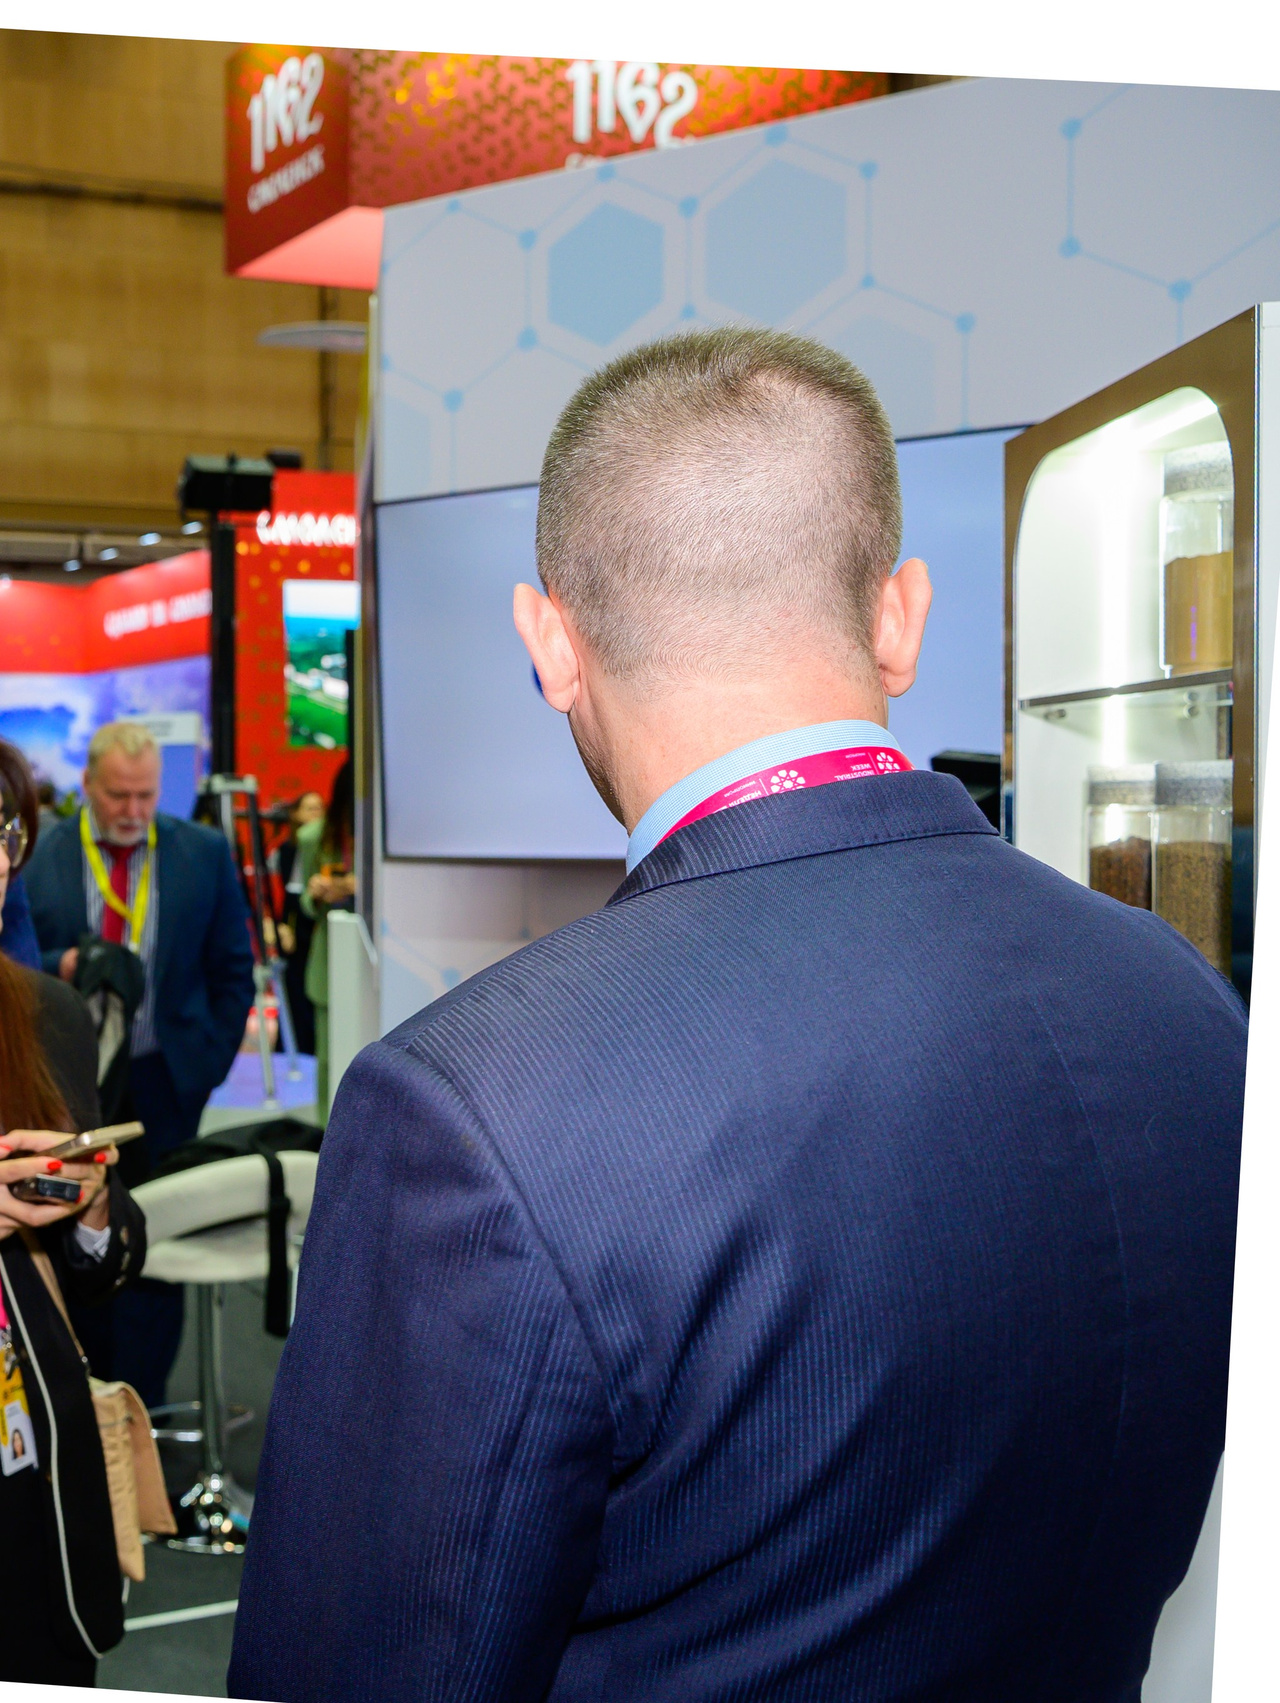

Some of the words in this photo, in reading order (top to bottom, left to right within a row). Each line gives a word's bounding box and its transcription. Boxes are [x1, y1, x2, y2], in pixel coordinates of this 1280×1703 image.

[565, 60, 698, 150] 1162
[850, 762, 872, 771] WEEK
[834, 769, 875, 781] INDUSTRIAL
